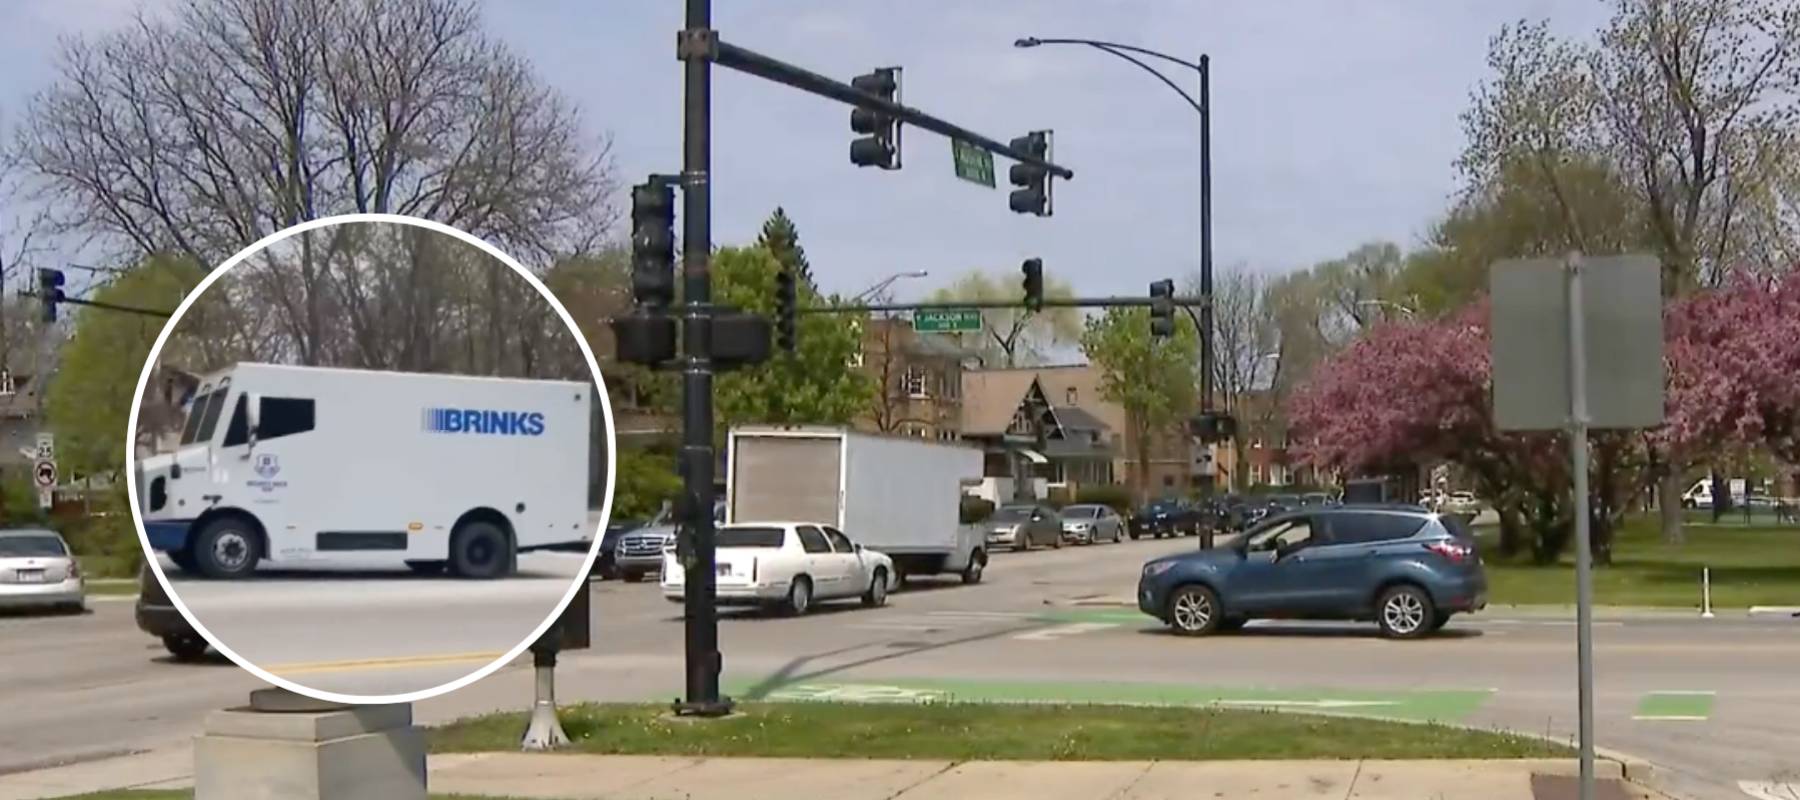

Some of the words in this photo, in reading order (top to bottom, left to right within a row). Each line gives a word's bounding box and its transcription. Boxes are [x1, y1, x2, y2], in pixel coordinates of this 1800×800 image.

[925, 312, 962, 322] JACKSON
[443, 408, 545, 436] BRINKS
[39, 446, 52, 458] 25
